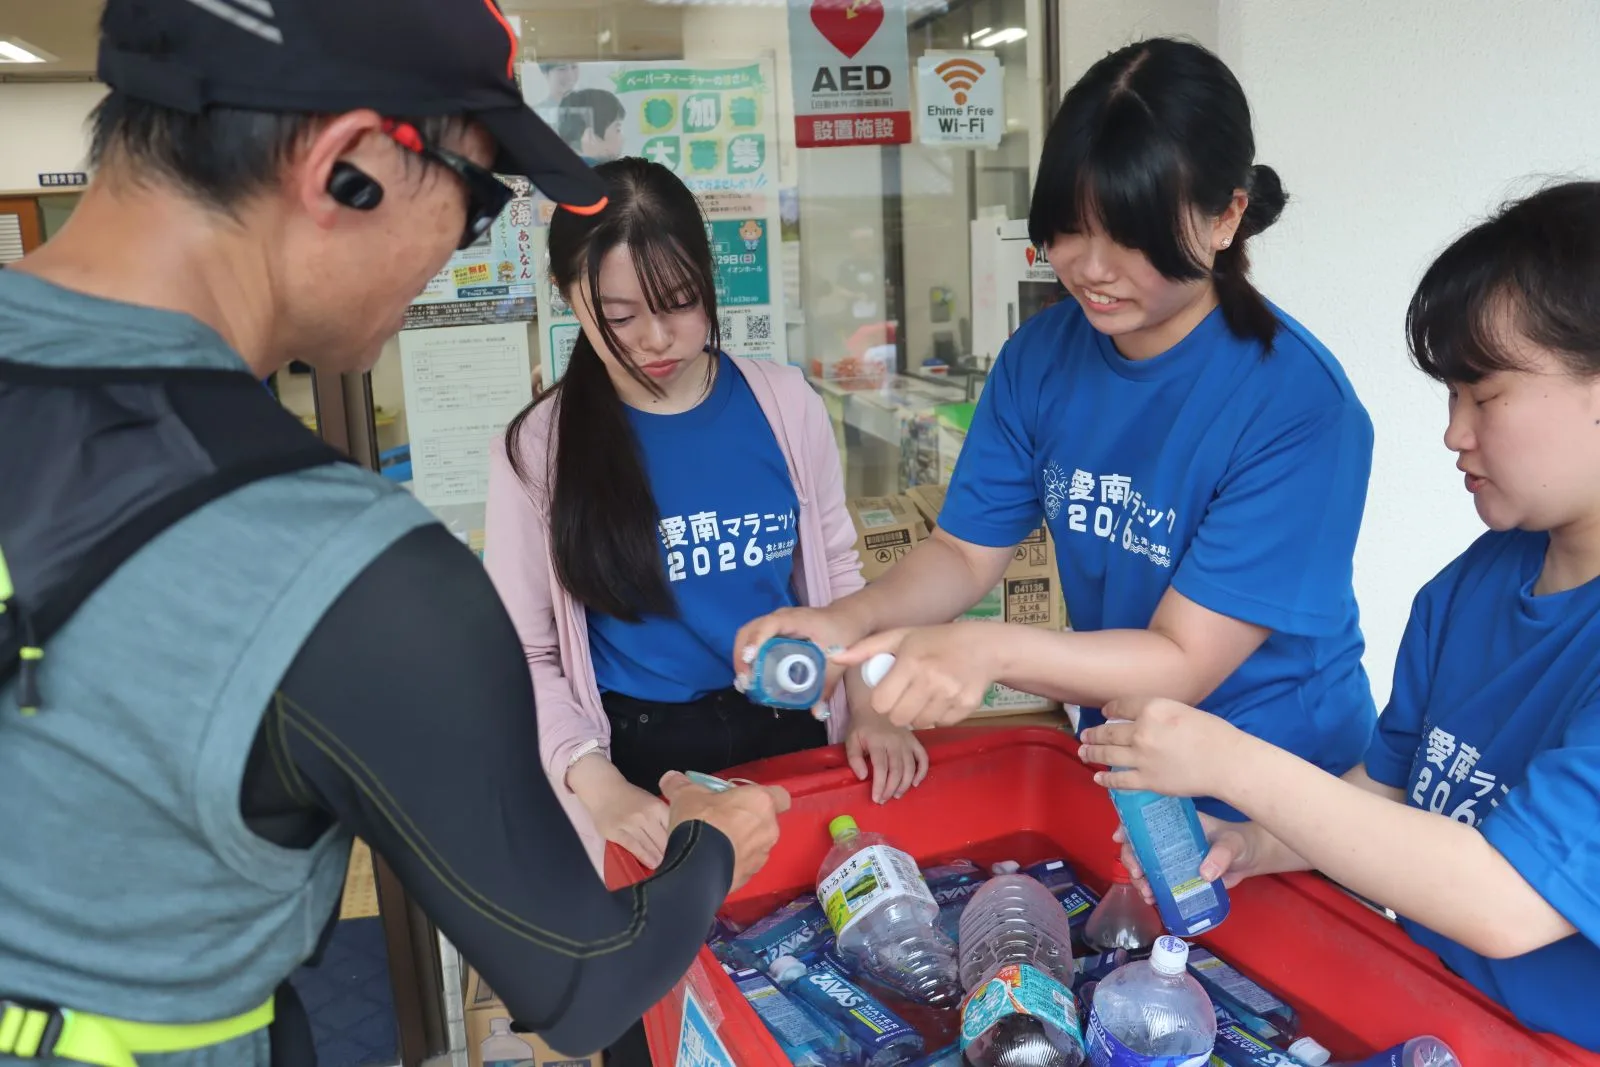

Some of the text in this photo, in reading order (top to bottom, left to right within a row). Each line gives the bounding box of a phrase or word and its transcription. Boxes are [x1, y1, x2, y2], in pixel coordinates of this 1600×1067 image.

[812, 65, 891, 92] AED
[928, 105, 994, 116] Ehime Free
[813, 118, 895, 141] 設置施設
[938, 118, 984, 133] Wi-Fi
[518, 229, 532, 279] あいなん
[713, 254, 755, 265] 29日(日)
[667, 537, 764, 582] 2026
[865, 1004, 899, 1029] WATER
